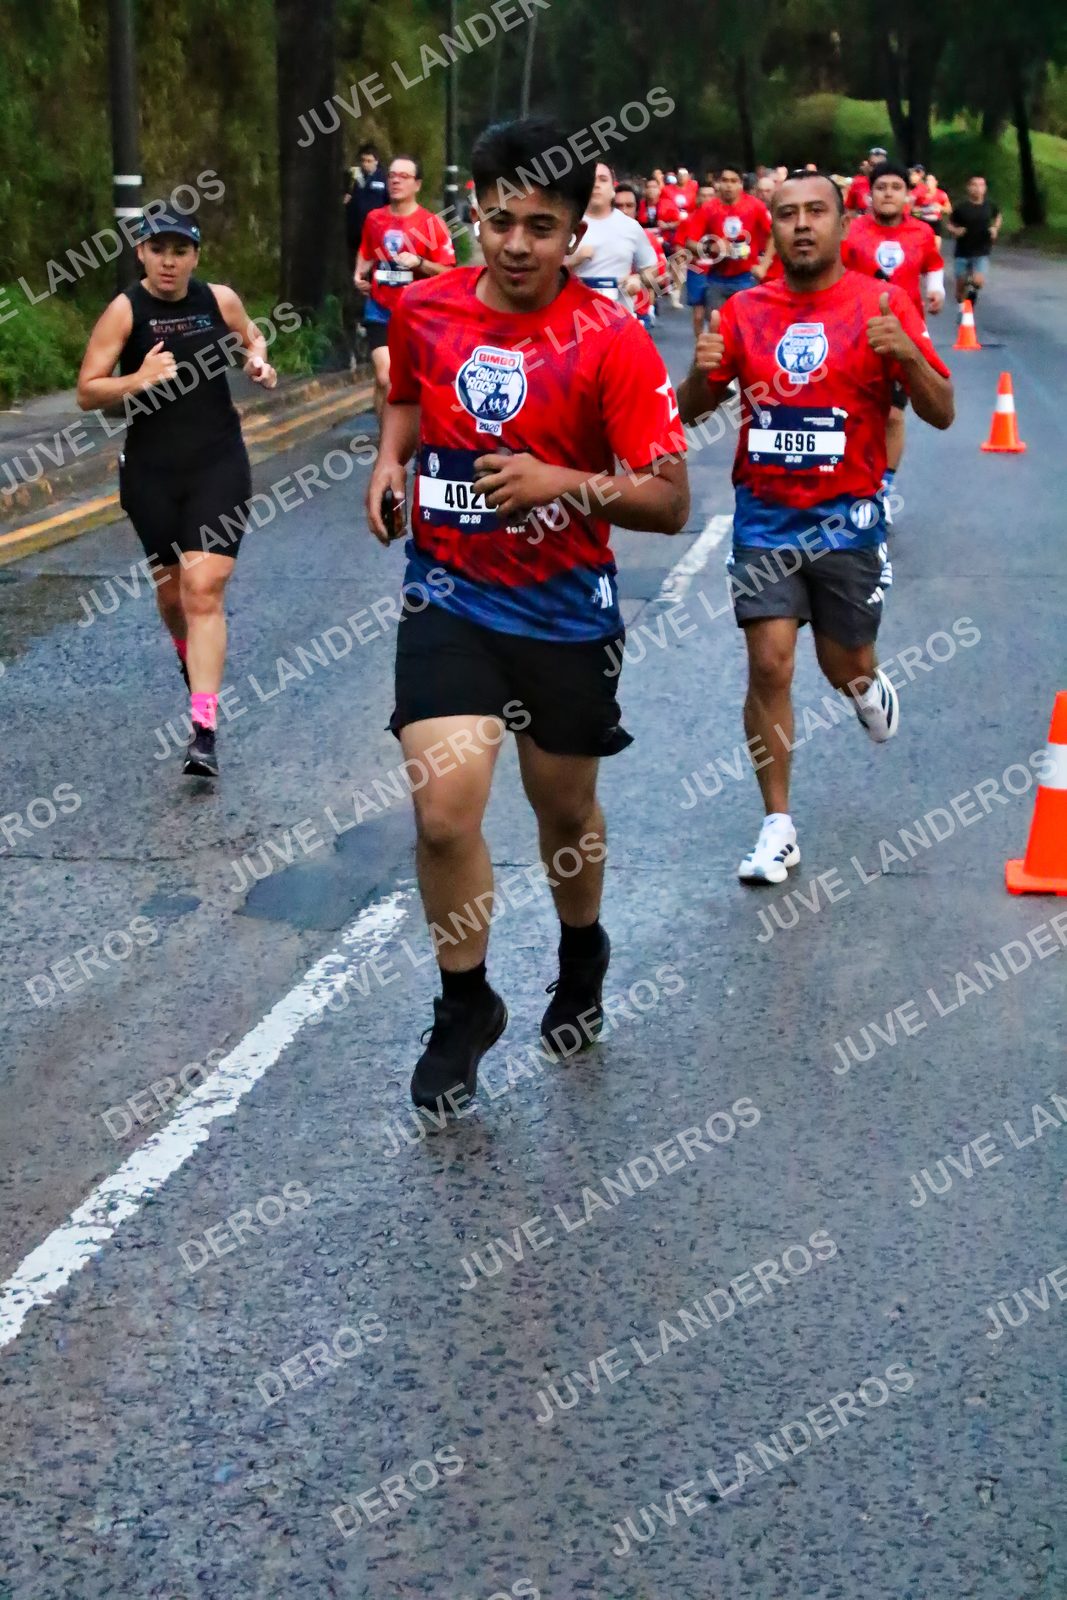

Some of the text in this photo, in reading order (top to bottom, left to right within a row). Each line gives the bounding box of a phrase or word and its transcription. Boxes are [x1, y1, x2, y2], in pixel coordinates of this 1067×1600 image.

[479, 353, 516, 367] BIMBO
[476, 366, 513, 385] Global
[466, 377, 497, 393] Race
[479, 422, 500, 433] 2026
[774, 432, 816, 452] 4696
[445, 483, 497, 510] 402
